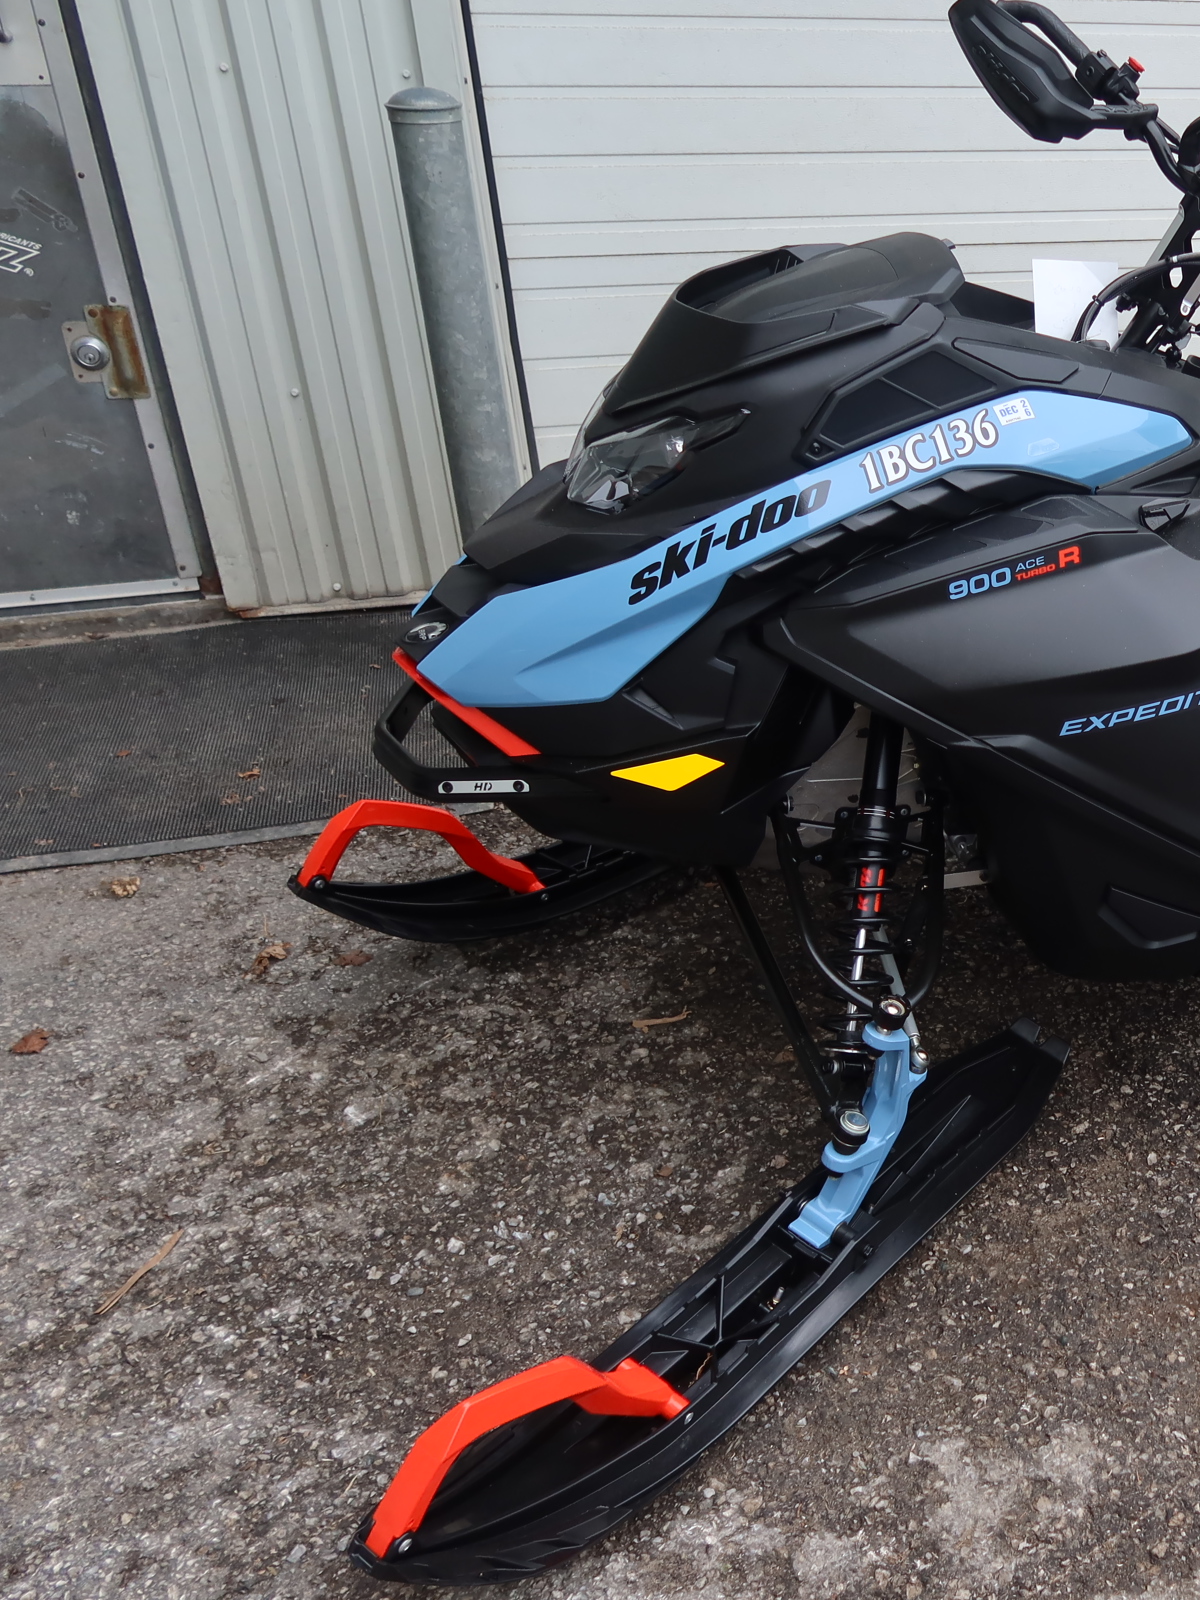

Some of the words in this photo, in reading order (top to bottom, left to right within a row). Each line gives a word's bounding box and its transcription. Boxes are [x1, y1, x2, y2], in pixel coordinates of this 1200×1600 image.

[999, 405, 1019, 418] DEC
[858, 408, 999, 494] 1BC136
[628, 479, 831, 606] ski-doo
[948, 567, 1012, 600] 900
[1015, 555, 1045, 573] ACE
[1058, 545, 1081, 569] R
[1015, 563, 1057, 582] TURBO
[473, 782, 493, 792] HD
